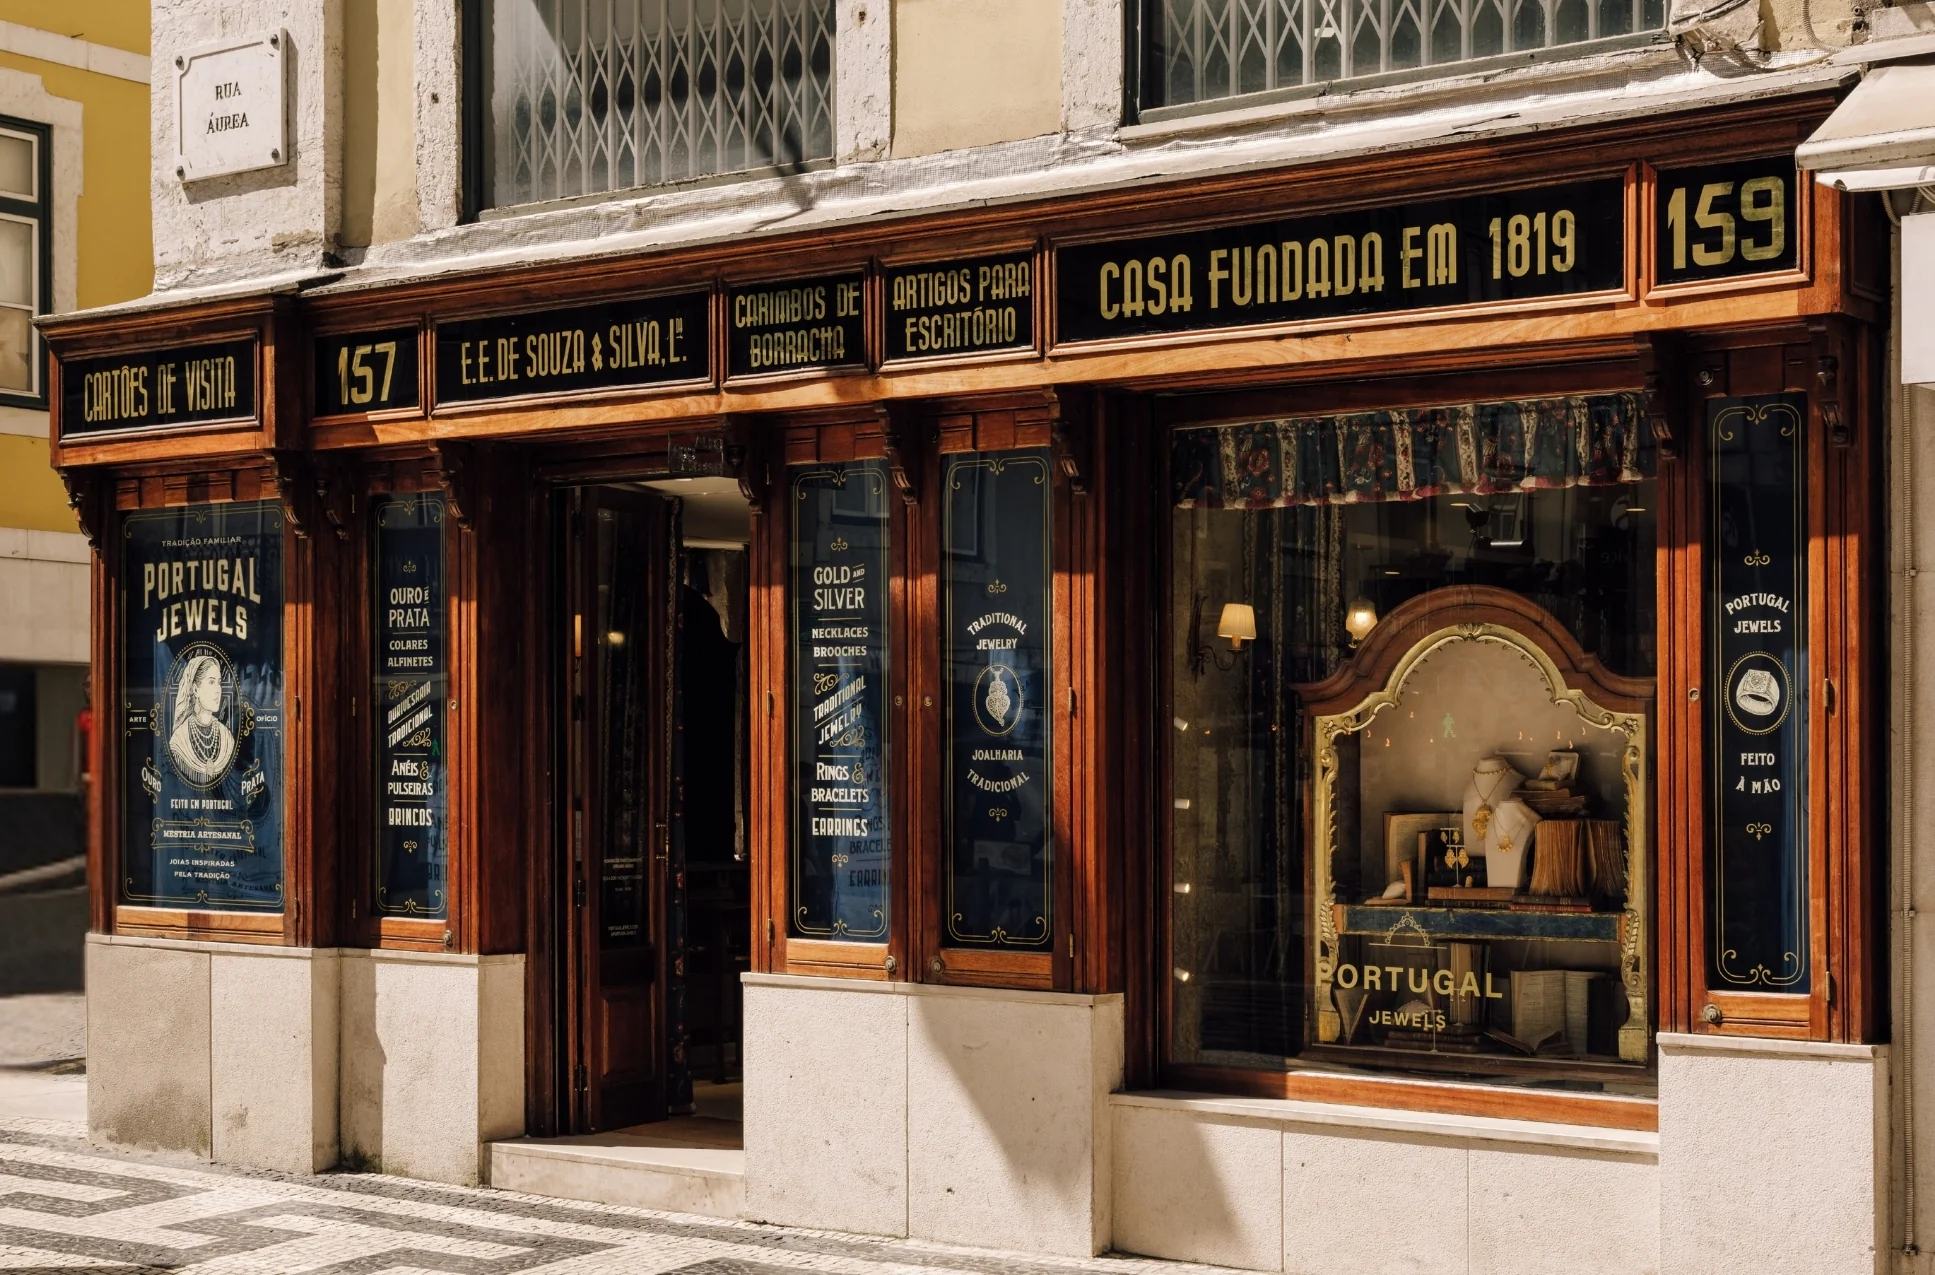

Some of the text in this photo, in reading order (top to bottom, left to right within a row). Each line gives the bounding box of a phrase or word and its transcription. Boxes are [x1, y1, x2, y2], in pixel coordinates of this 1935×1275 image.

[215, 81, 242, 101] RUA
[206, 112, 249, 134] ÁUREA
[1667, 176, 1785, 269] 159
[1100, 209, 1576, 320] CASA FUNDADA EM 1819
[893, 261, 1030, 311] ARTIGOS PARA
[735, 281, 860, 328] CARIMBOS DE
[905, 306, 1016, 352] ESCRITÓRIO
[526, 329, 585, 378] SOUZA
[592, 332, 603, 372] &
[609, 320, 664, 369] SILVA,
[750, 325, 845, 368] BORRACHA
[338, 341, 396, 405] 157
[157, 363, 176, 415] DE
[185, 355, 236, 412] VISITA
[162, 536, 241, 547] TRADIÇÃO FAMILIAR
[144, 557, 261, 610] PORTUGAL
[813, 566, 865, 585] GOLD AND
[390, 587, 423, 605] OURO
[813, 587, 865, 611] SILVER
[1725, 592, 1791, 616] PORTUGAL
[156, 598, 248, 643] JEWELS
[389, 608, 430, 628] PRATA
[967, 612, 1028, 636] TRADITIONAL
[1734, 619, 1781, 634] JEWELS
[812, 627, 868, 639] NECKLACES
[389, 639, 428, 650] COLARES
[813, 646, 867, 658] BROOCHES
[976, 638, 1017, 650] JEWELRY
[387, 656, 433, 667] ALFINETES
[388, 680, 431, 724] OURIVESARIA
[813, 675, 867, 722] TRADITIONAL
[256, 714, 278, 722] OFÍCIO
[388, 704, 433, 748] TRADICIONAL
[818, 703, 862, 745] JEWELRY
[972, 750, 1024, 761] JOALHARIA
[1740, 752, 1775, 766] FEITO
[141, 767, 162, 793] OURO
[391, 760, 432, 780] ANÉIS &
[816, 762, 867, 784] RINGS &
[241, 771, 265, 795] PRATA
[387, 782, 433, 795] PULSEIRAS
[966, 769, 1030, 793] TRADICIONAL
[1751, 778, 1781, 794] MÃO
[171, 799, 234, 810] FEITO EM PORTUGAL
[811, 788, 869, 803] BRACELETS
[388, 808, 433, 826] BRINCOS
[812, 817, 868, 837] EARRINGS
[163, 830, 242, 839] MESTRIA ARTESANAL
[193, 871, 230, 880] TRADIÇÃO
[1316, 962, 1503, 999] PORTUGAL
[1369, 1010, 1447, 1029] JEWELS
